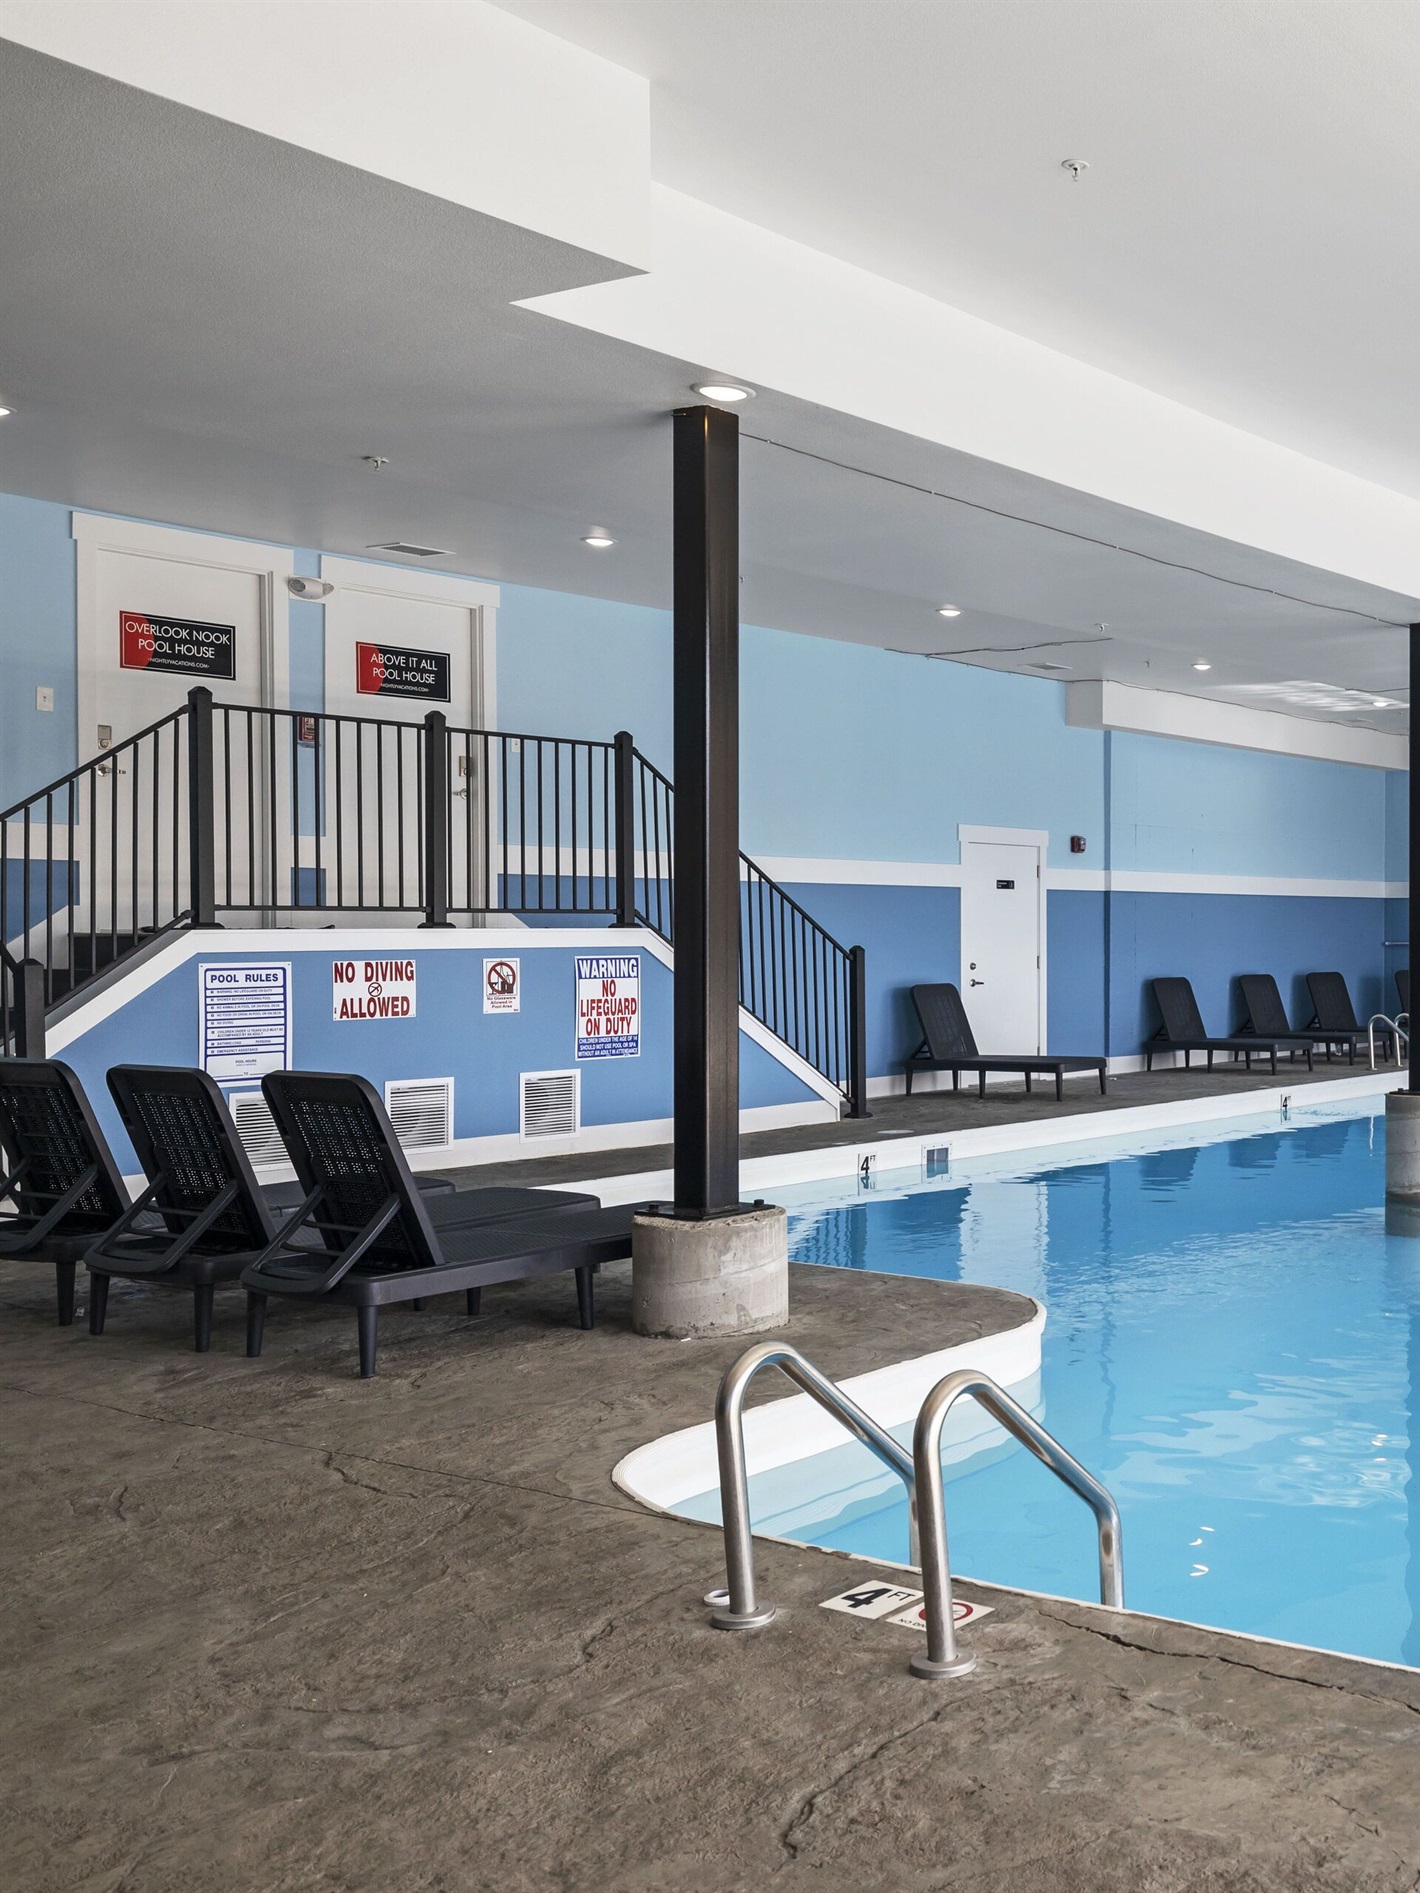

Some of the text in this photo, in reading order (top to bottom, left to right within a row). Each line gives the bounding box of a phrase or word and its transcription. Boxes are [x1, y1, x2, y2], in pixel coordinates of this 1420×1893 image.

[126, 622, 230, 645] OVERLOOK NOOK
[138, 639, 216, 658] POOL HOUSE
[370, 654, 438, 670] ABOVE IT ALL
[373, 668, 436, 684] POOL HOUSE
[334, 961, 414, 983] NO DIVING
[579, 959, 637, 978] WARNING
[210, 974, 278, 983] POOL RULES
[602, 979, 616, 997] NO
[340, 996, 410, 1019] ALLOWED
[581, 998, 637, 1017] LIFEGUARD
[586, 1016, 632, 1036] ON DUTY
[1283, 1096, 1287, 1108] 4
[860, 1156, 870, 1175] 4
[841, 1588, 916, 1609] 4 FT
